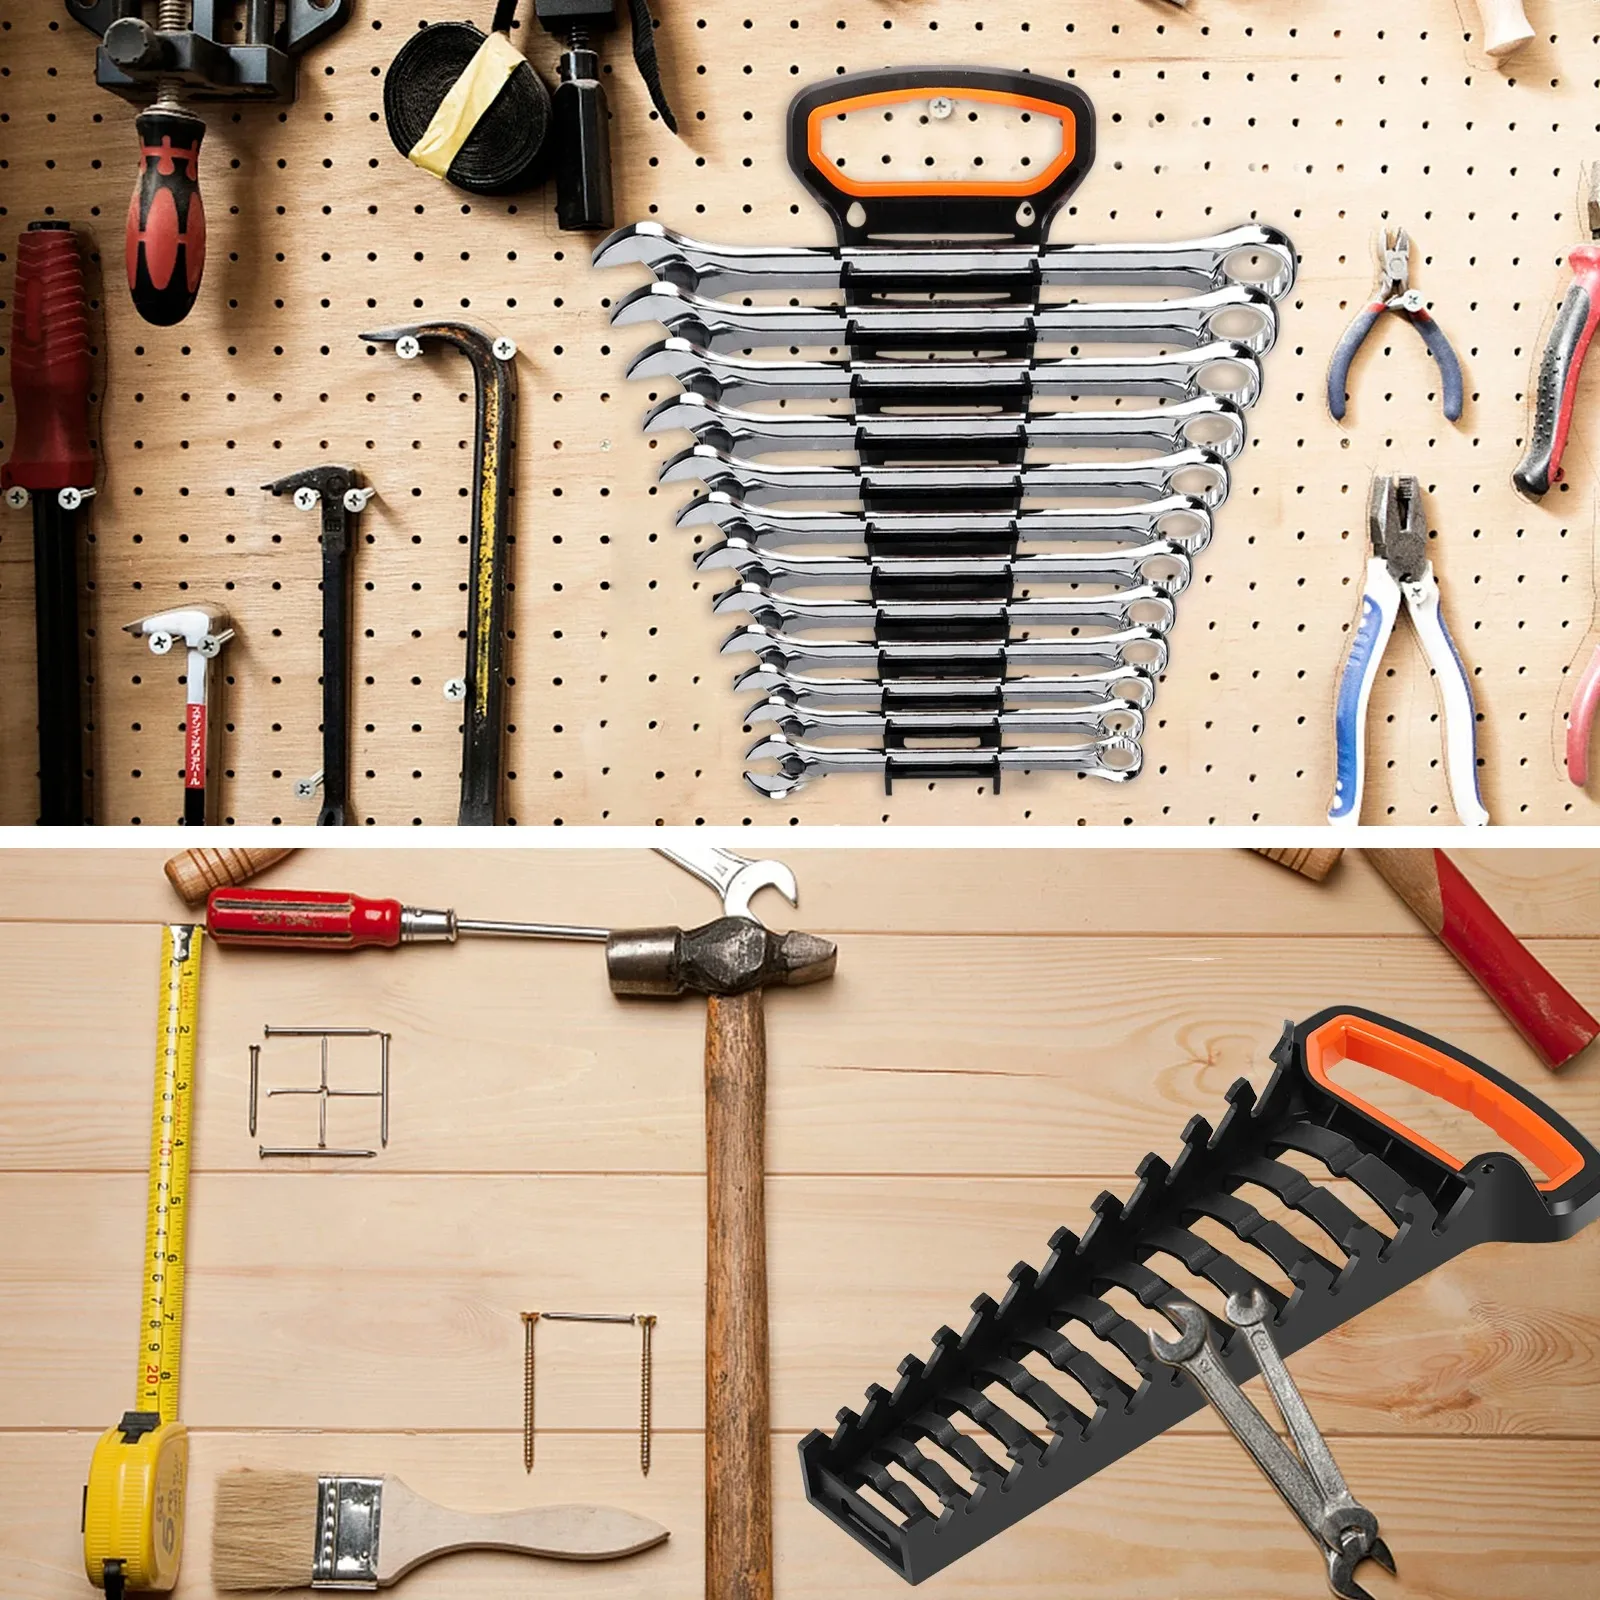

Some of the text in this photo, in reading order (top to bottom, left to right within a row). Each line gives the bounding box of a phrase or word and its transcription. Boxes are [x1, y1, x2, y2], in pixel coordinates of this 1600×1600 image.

[179, 1025, 190, 1034] 2
[176, 1081, 187, 1091] 3
[174, 1139, 184, 1147] 4
[157, 1182, 169, 1190] 2
[171, 1196, 181, 1205] 5
[155, 1205, 168, 1213] 3
[155, 1228, 167, 1236] 4
[154, 1251, 166, 1260] 5
[167, 1254, 178, 1263] 6
[152, 1273, 164, 1283] 6
[151, 1296, 163, 1305] 7
[164, 1312, 175, 1321] 7
[149, 1319, 162, 1329] 8
[148, 1342, 160, 1352] 9
[146, 1364, 159, 1384] 20
[160, 1371, 172, 1380] 8
